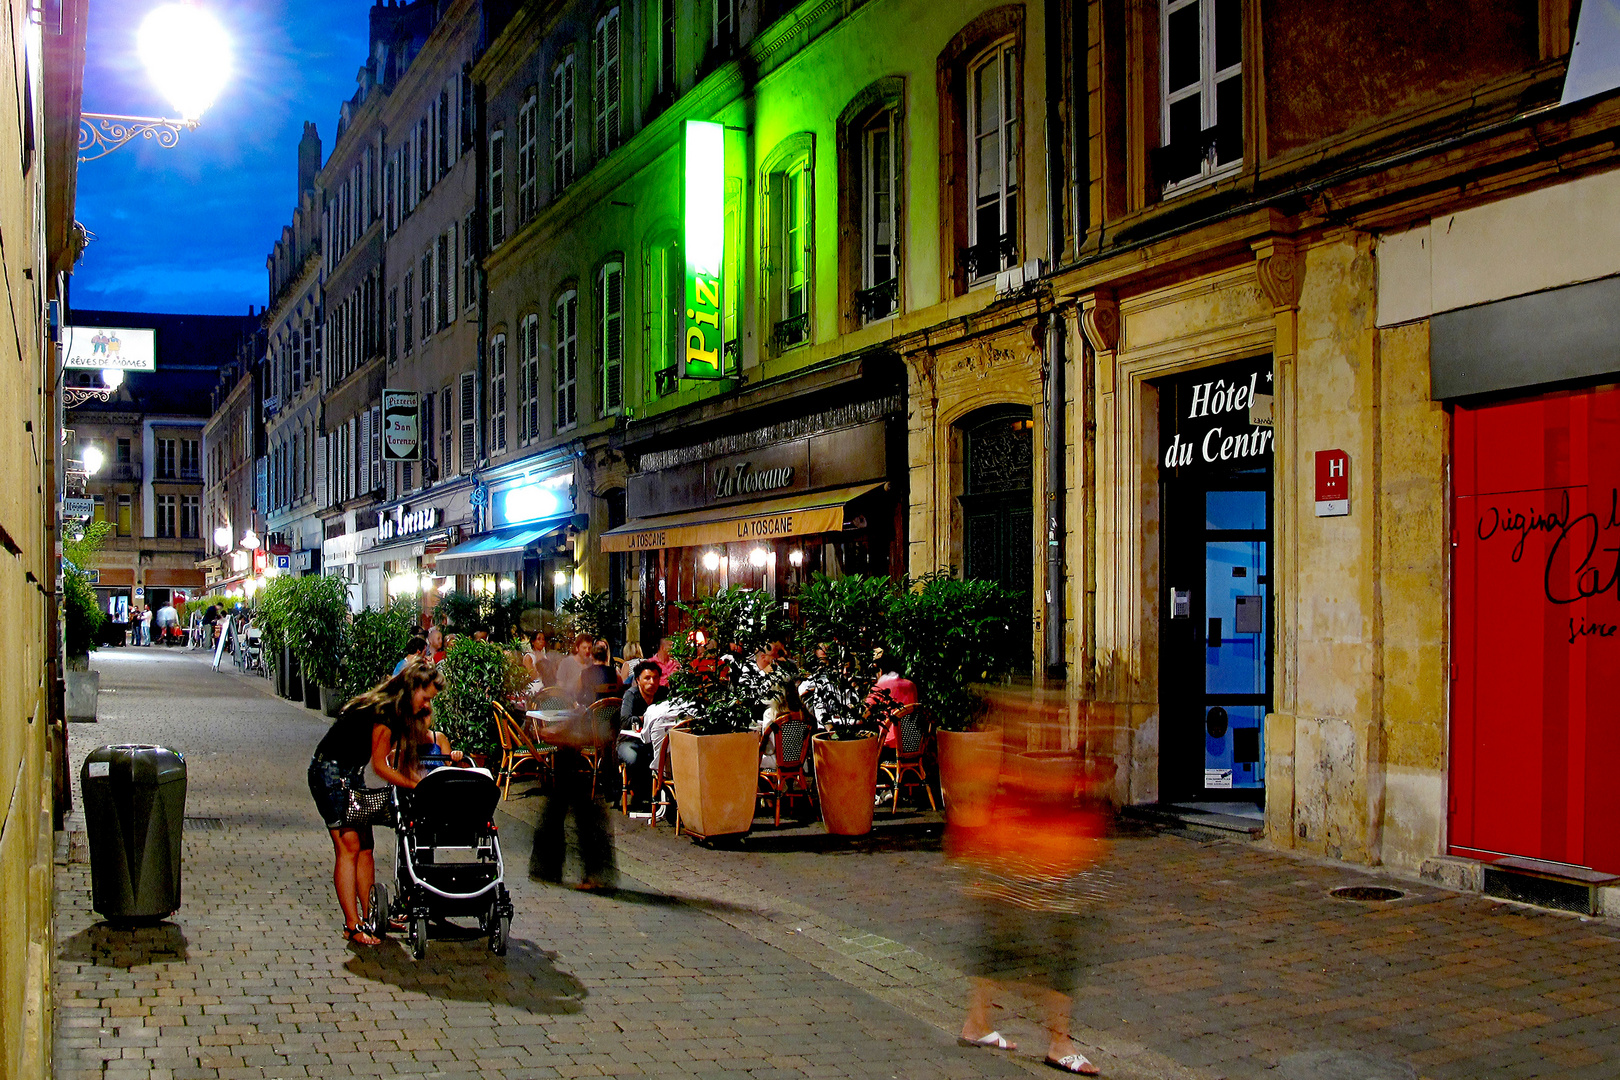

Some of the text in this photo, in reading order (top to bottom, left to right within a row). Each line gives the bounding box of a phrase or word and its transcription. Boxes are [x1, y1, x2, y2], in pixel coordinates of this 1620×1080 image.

[70, 356, 97, 366] RÊVES
[98, 358, 109, 366] DE
[388, 397, 417, 406] Pizzeria
[1187, 372, 1257, 419] Hôtel
[394, 421, 411, 431] San
[387, 435, 416, 445] Lorenzo
[1164, 426, 1275, 468] du Centr
[1329, 458, 1344, 478] H
[713, 462, 793, 499] La Toscane
[737, 516, 793, 537] LA TOSCANE
[1478, 490, 1570, 563] Original
[627, 531, 666, 549] LA TOSCANE
[280, 556, 287, 567] P
[1569, 617, 1617, 644] since
